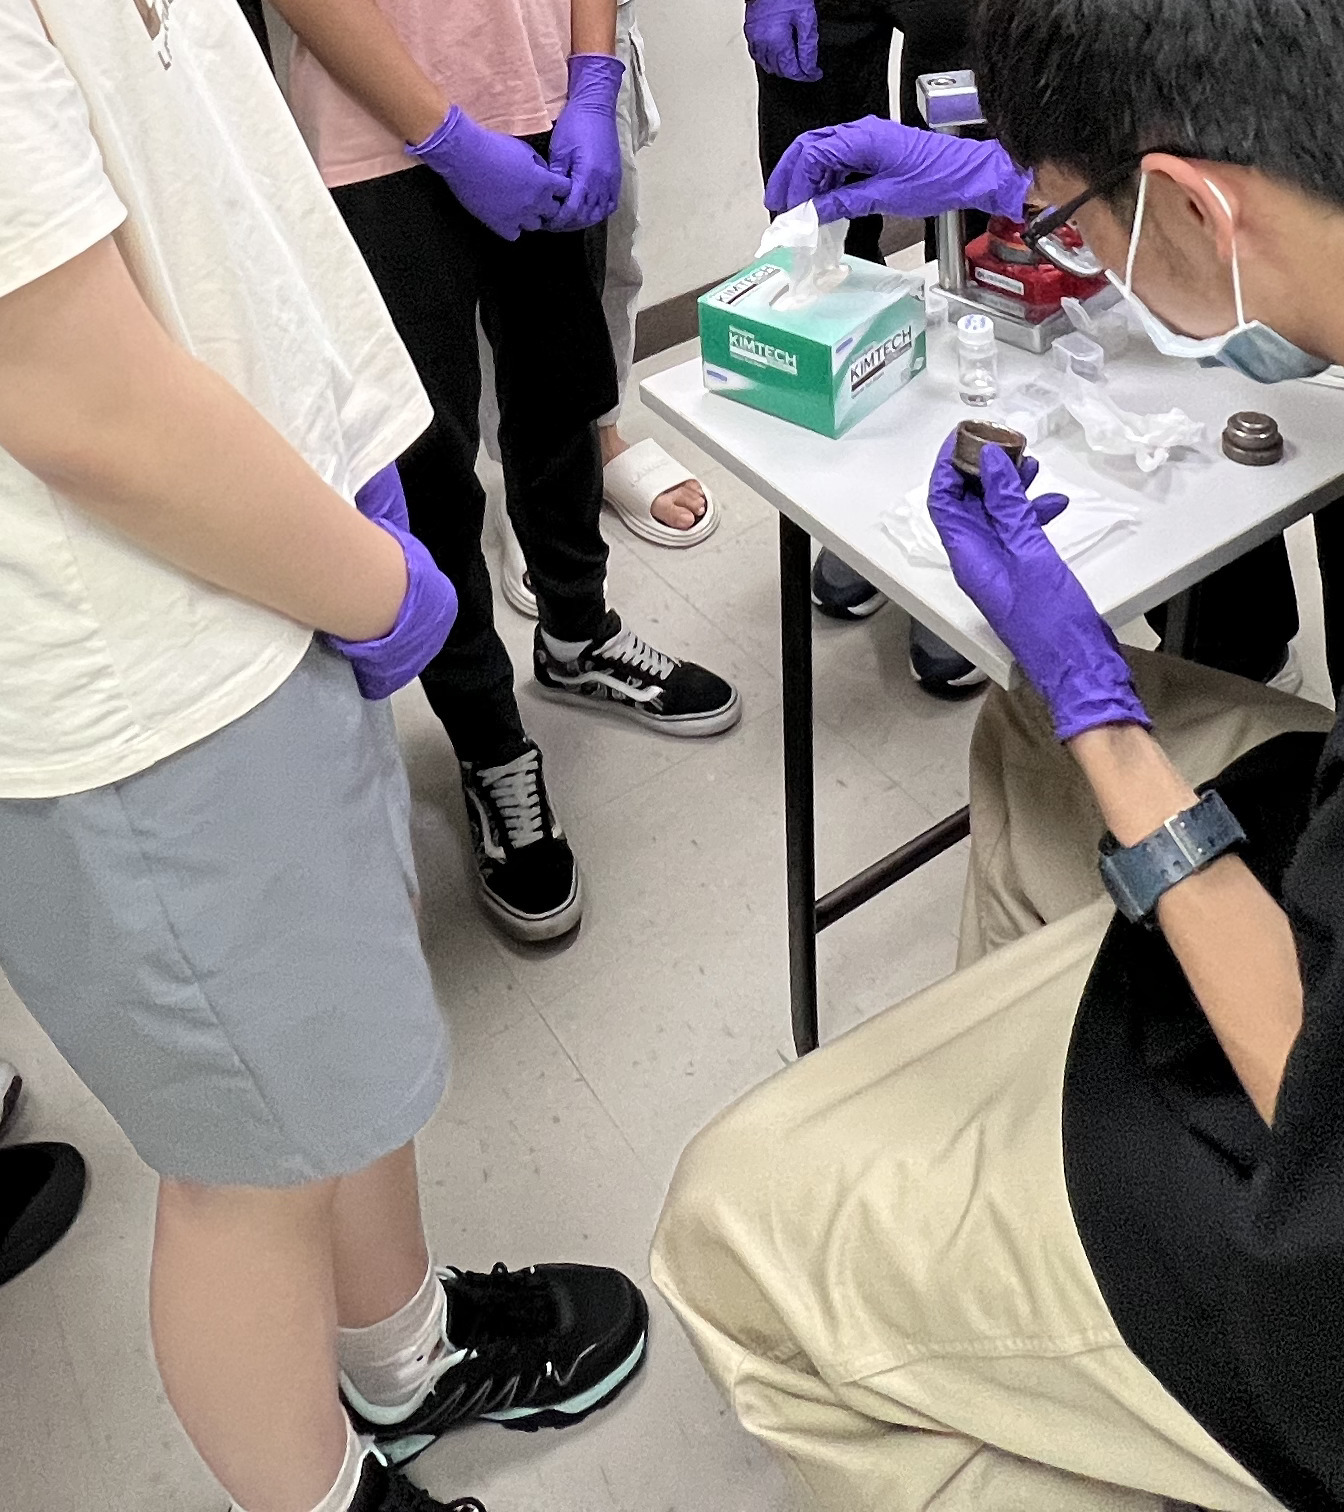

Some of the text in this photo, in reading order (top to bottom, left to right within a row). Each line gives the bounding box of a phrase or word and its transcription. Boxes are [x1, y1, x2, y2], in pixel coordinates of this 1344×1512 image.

[717, 264, 778, 304] KIMTECH
[729, 330, 798, 369] KIMTECH
[850, 325, 912, 382] KIMTECH
